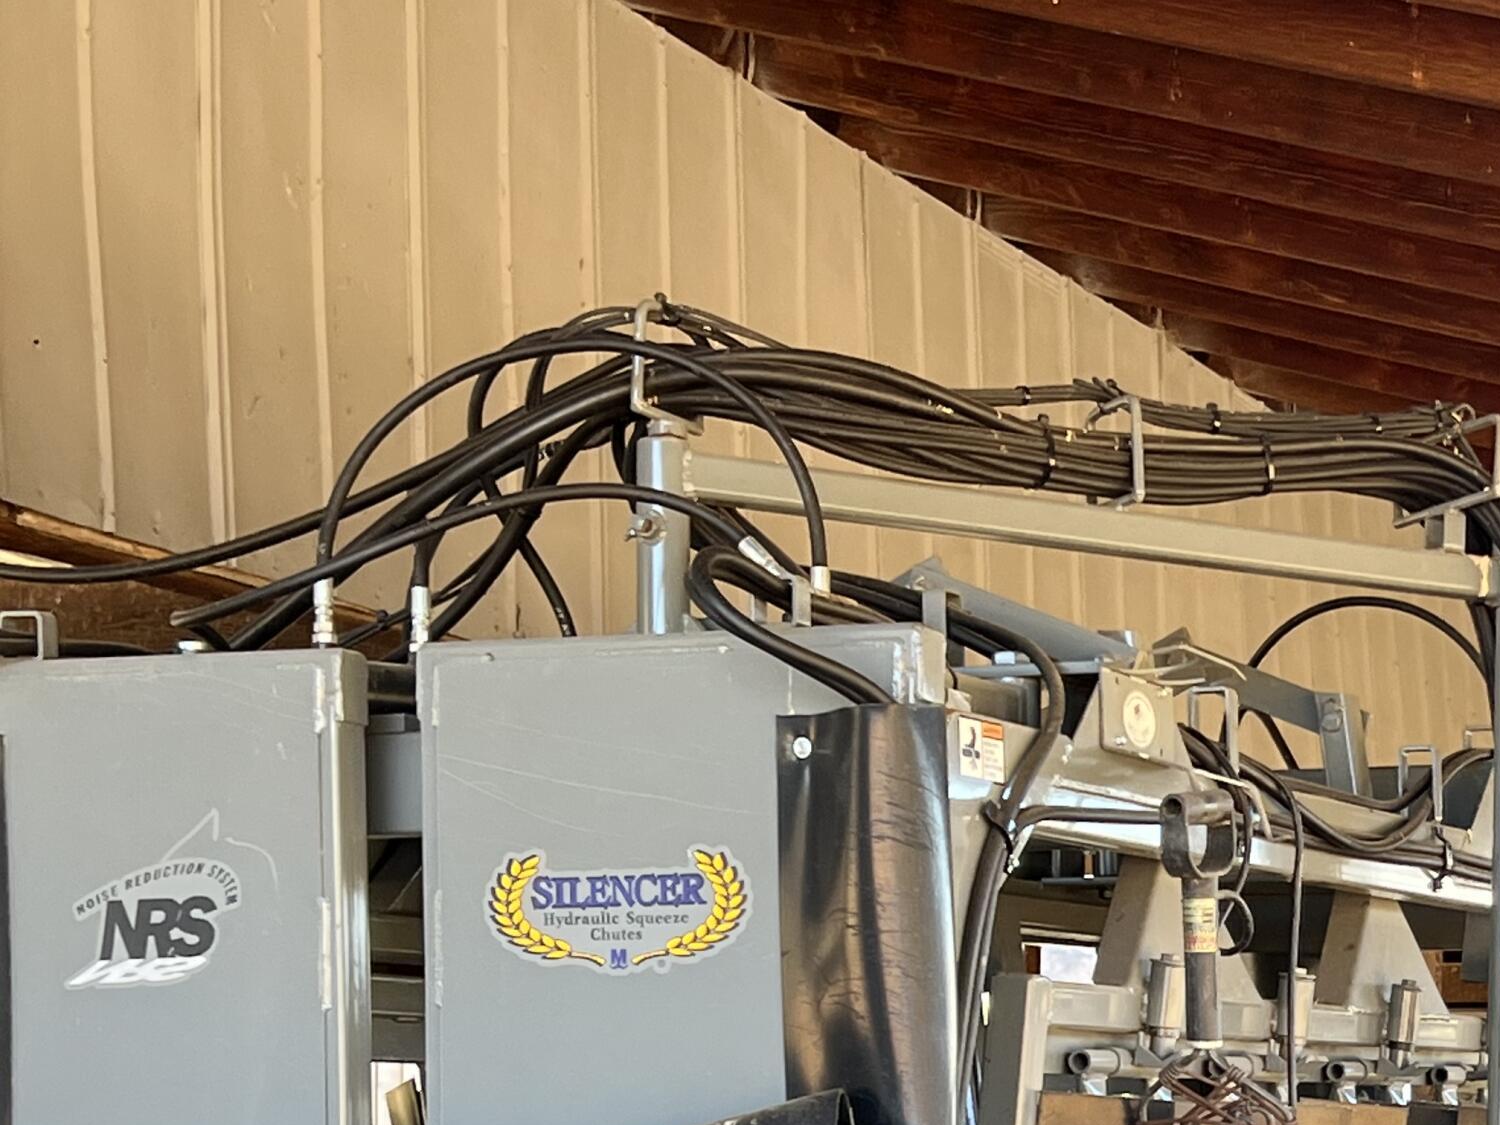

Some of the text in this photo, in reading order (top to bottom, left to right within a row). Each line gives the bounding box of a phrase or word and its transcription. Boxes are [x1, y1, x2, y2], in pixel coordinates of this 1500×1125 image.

[76, 862, 238, 915] NOISE REDUCTION SYSTEM
[531, 873, 706, 909] SILENCER
[100, 895, 217, 961] NRS
[543, 911, 689, 926] Hydraulic Squeeze
[590, 928, 642, 942] Chutes
